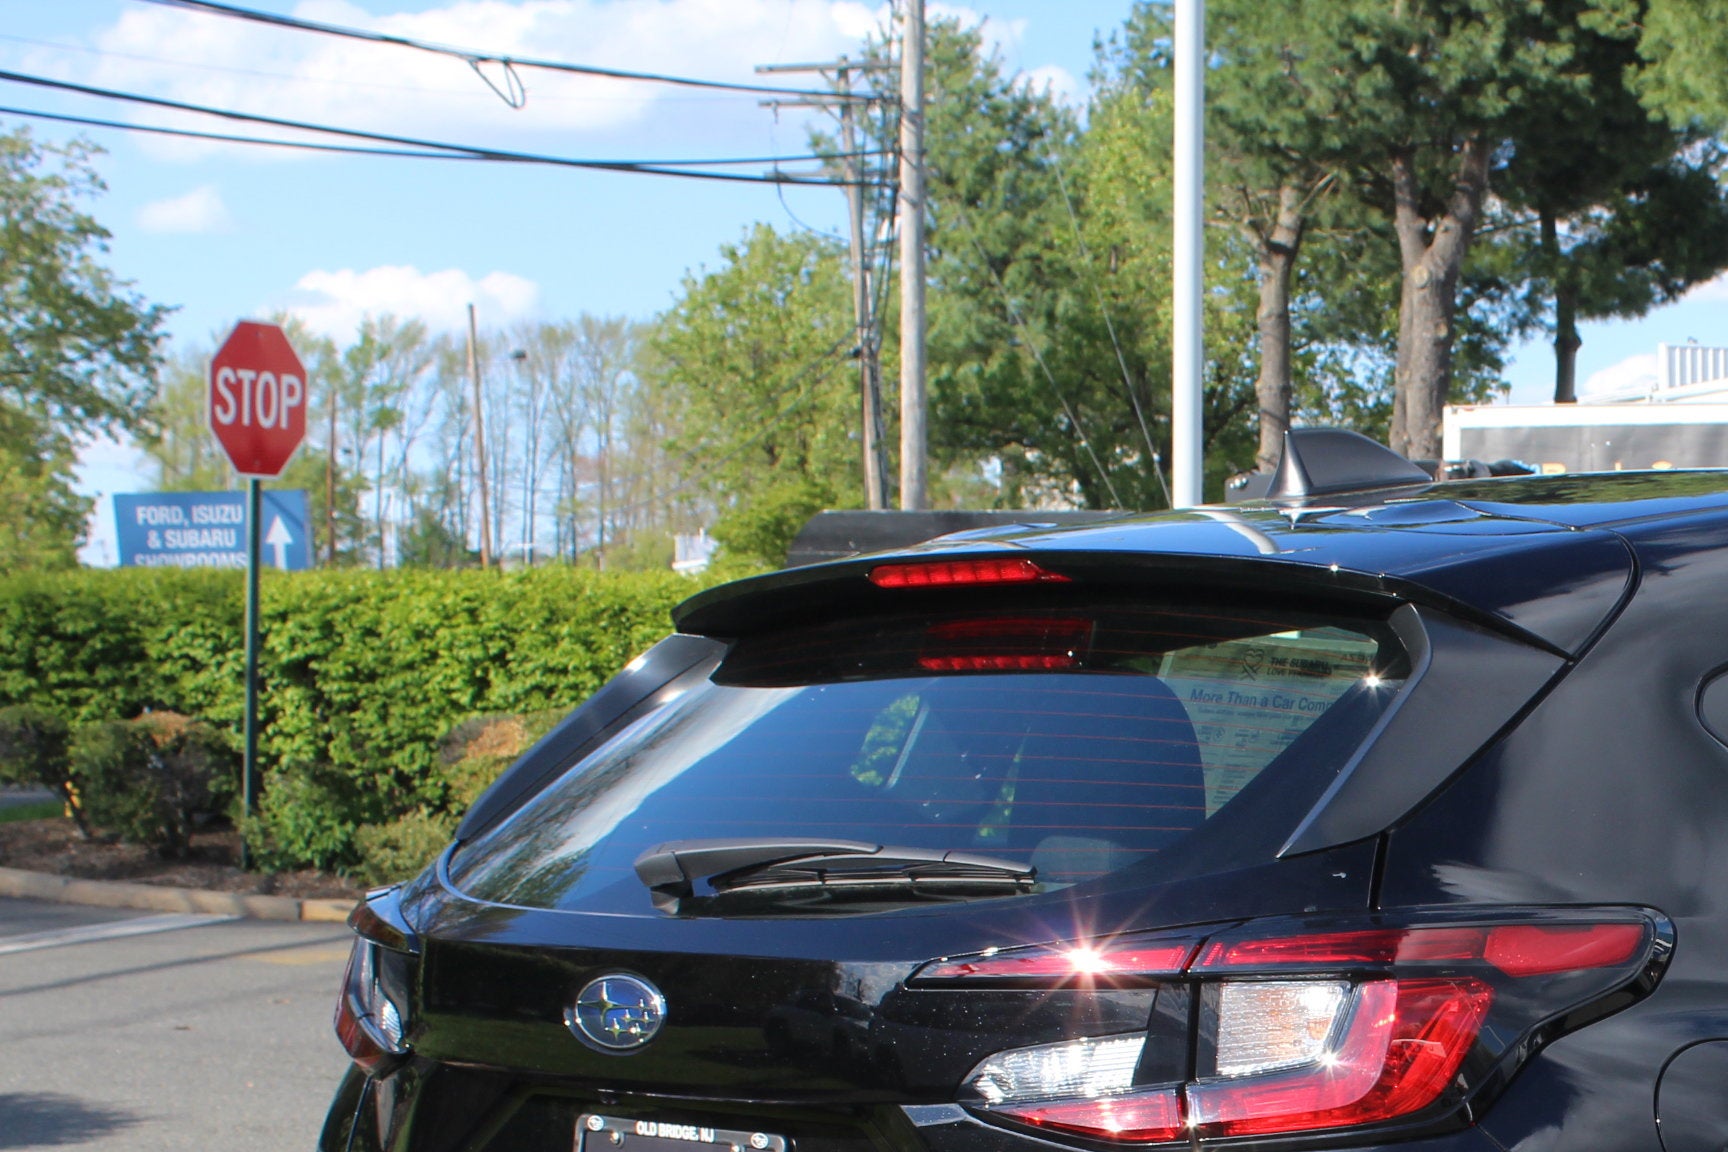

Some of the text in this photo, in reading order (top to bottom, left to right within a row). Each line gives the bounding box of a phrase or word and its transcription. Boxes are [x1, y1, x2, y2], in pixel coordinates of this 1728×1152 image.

[215, 366, 302, 430] STOP
[136, 504, 243, 526] FORD, ISUZU
[147, 528, 236, 548] & SUBARU
[1190, 688, 1224, 702] More
[1228, 691, 1258, 707] Than
[1260, 694, 1268, 707] a
[1272, 694, 1296, 711] Car
[636, 1120, 657, 1136] OLD
[700, 1127, 715, 1143] NJ
